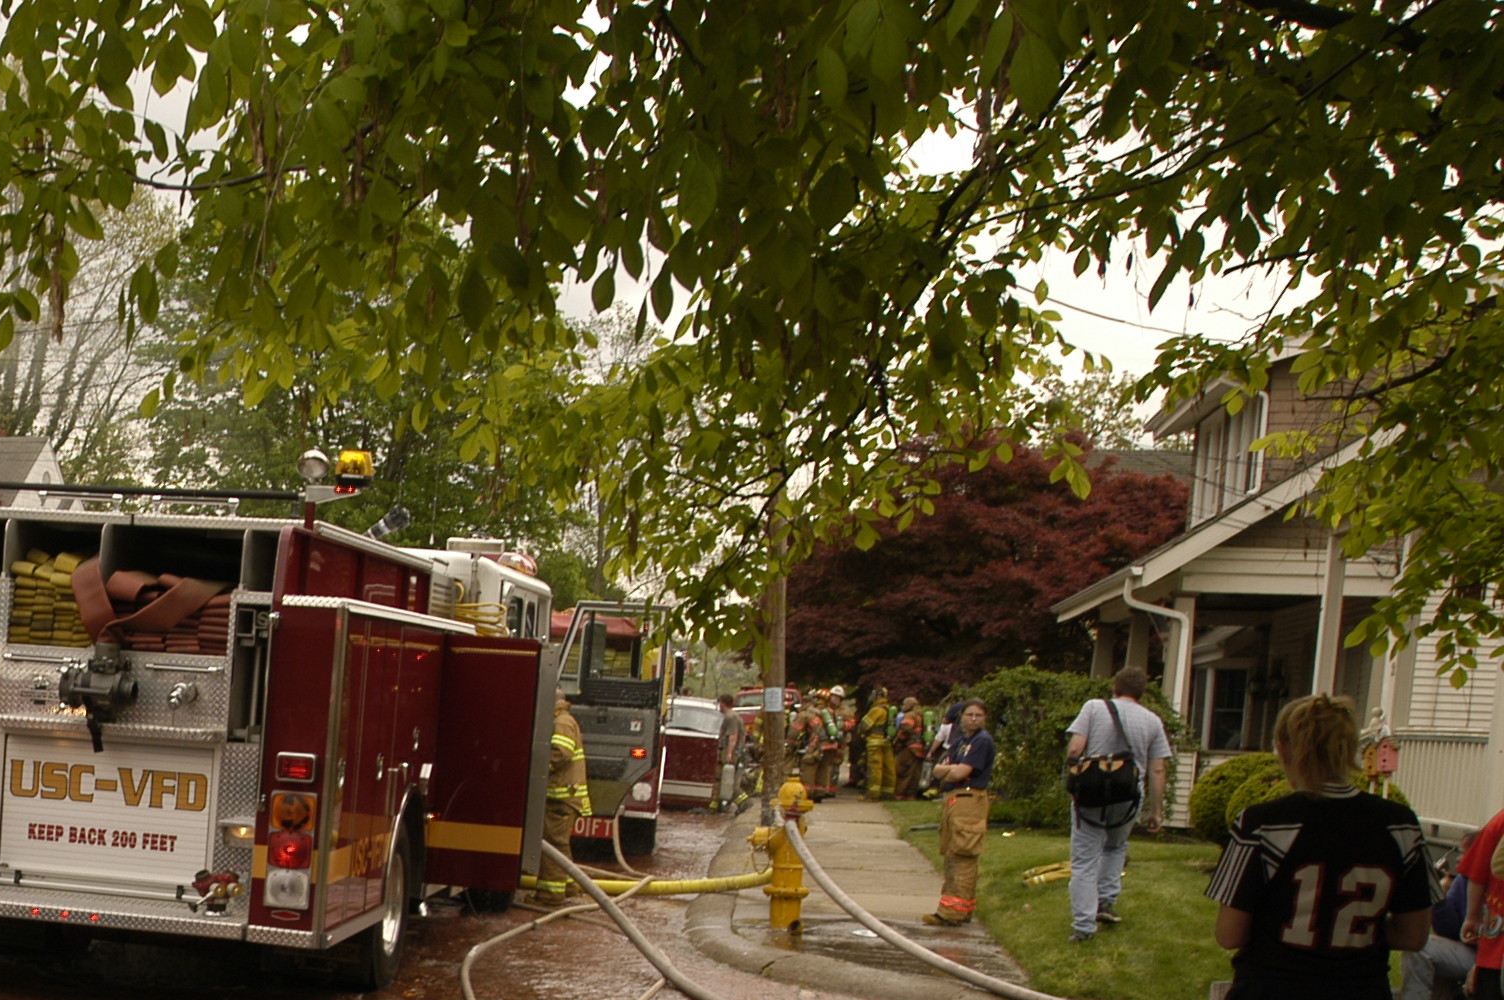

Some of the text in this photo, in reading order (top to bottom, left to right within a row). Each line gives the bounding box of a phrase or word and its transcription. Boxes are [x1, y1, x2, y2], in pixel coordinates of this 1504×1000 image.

[10, 759, 208, 812] USC-VFD
[28, 823, 177, 852] KEEP BACK 200 FEET
[1280, 862, 1394, 950] 12
